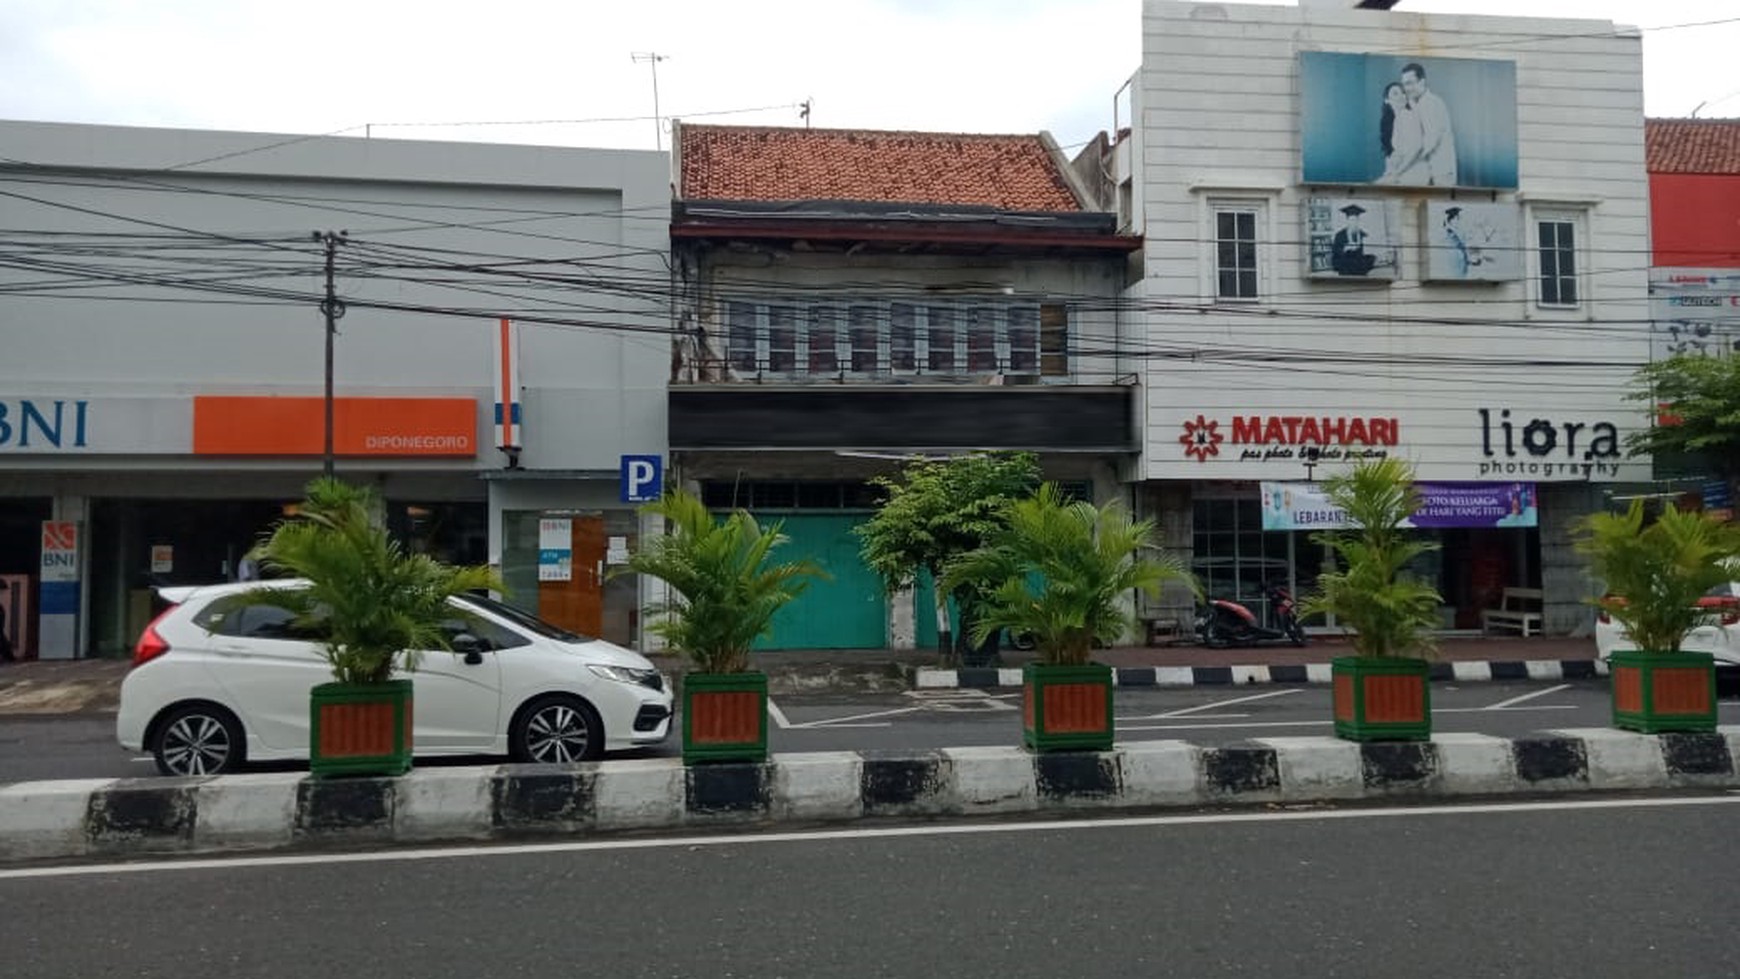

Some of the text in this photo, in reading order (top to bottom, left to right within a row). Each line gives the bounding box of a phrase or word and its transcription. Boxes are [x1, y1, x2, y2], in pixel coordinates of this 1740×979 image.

[1232, 416, 1398, 446] MATAHARI
[1478, 408, 1621, 457] liora
[365, 435, 468, 450] DIPONEGORO
[1240, 448, 1261, 462] pas
[1262, 446, 1293, 462] photo
[629, 461, 654, 496] P
[1293, 509, 1342, 524] LEBARAN
[43, 552, 75, 567] BNI
